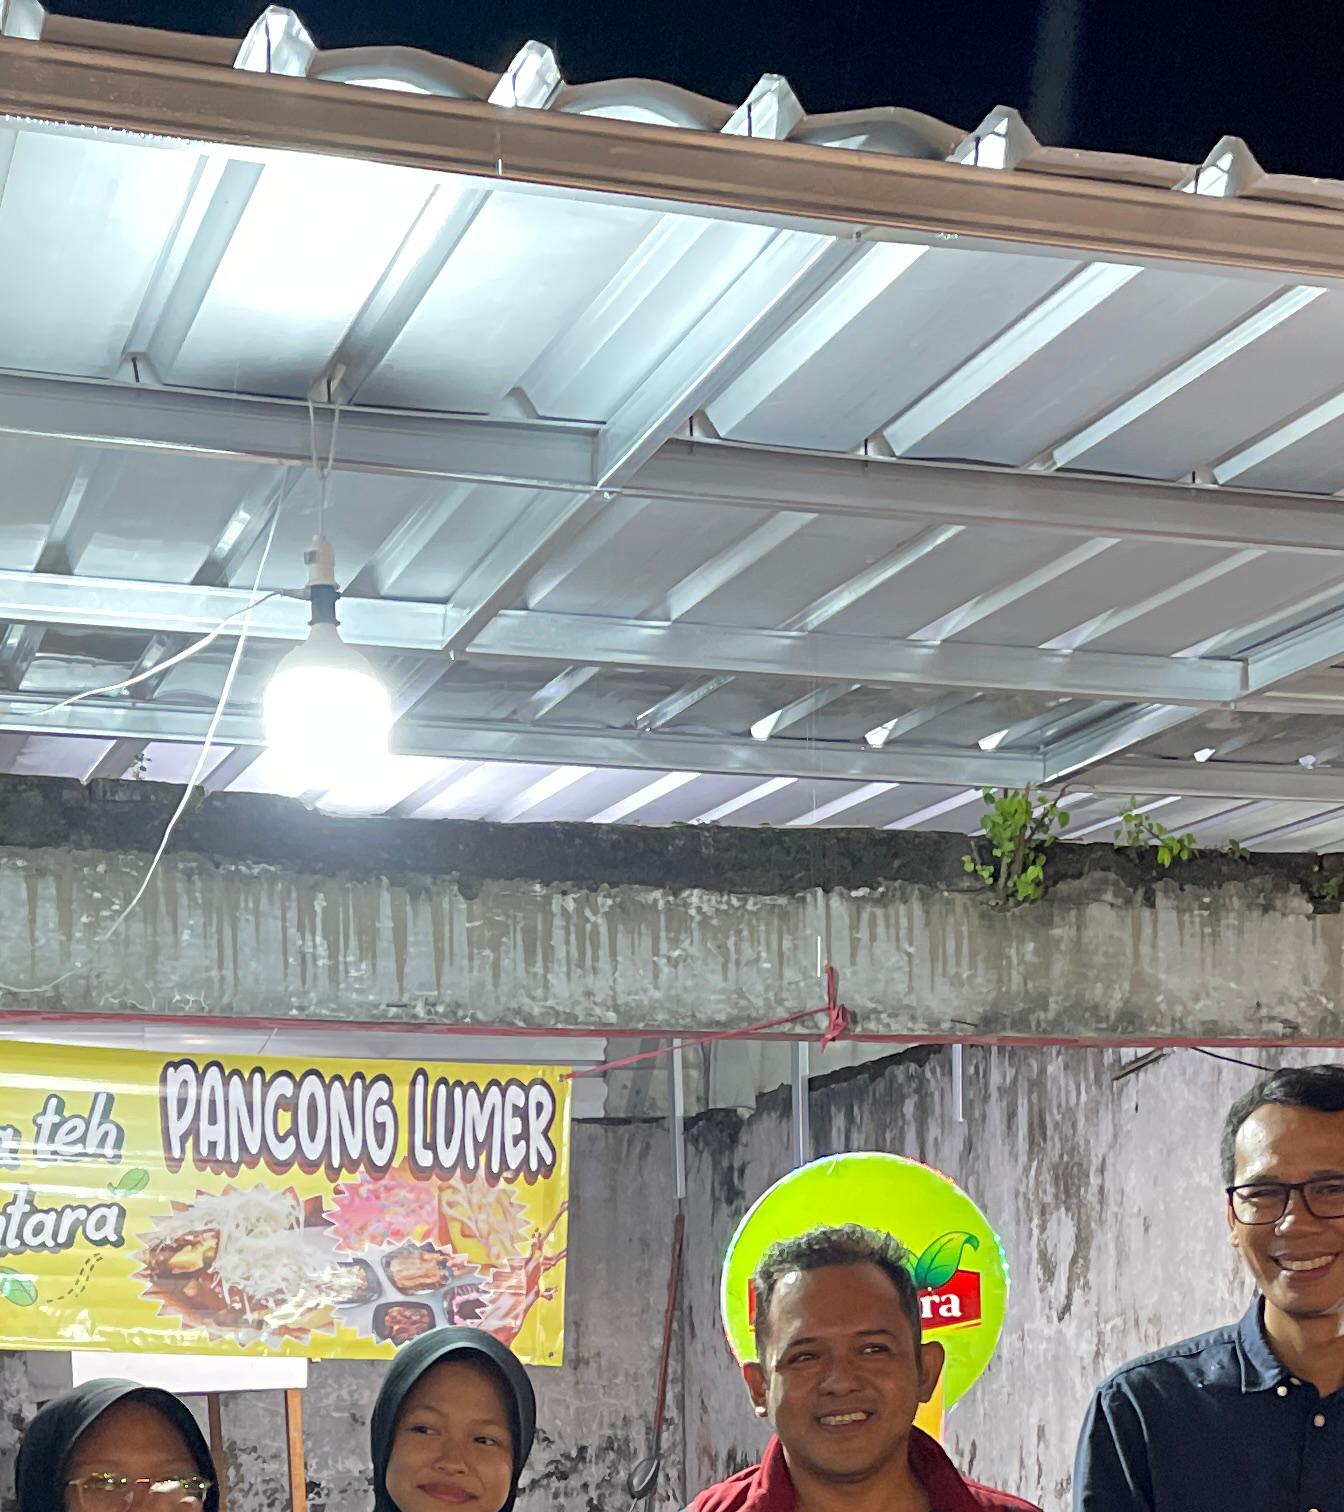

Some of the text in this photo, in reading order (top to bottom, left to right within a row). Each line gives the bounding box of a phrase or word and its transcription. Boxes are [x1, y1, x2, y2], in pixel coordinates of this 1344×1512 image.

[34, 1093, 121, 1167] teh
[161, 1059, 558, 1187] PANCONG LUMER
[919, 1293, 963, 1319] ra
